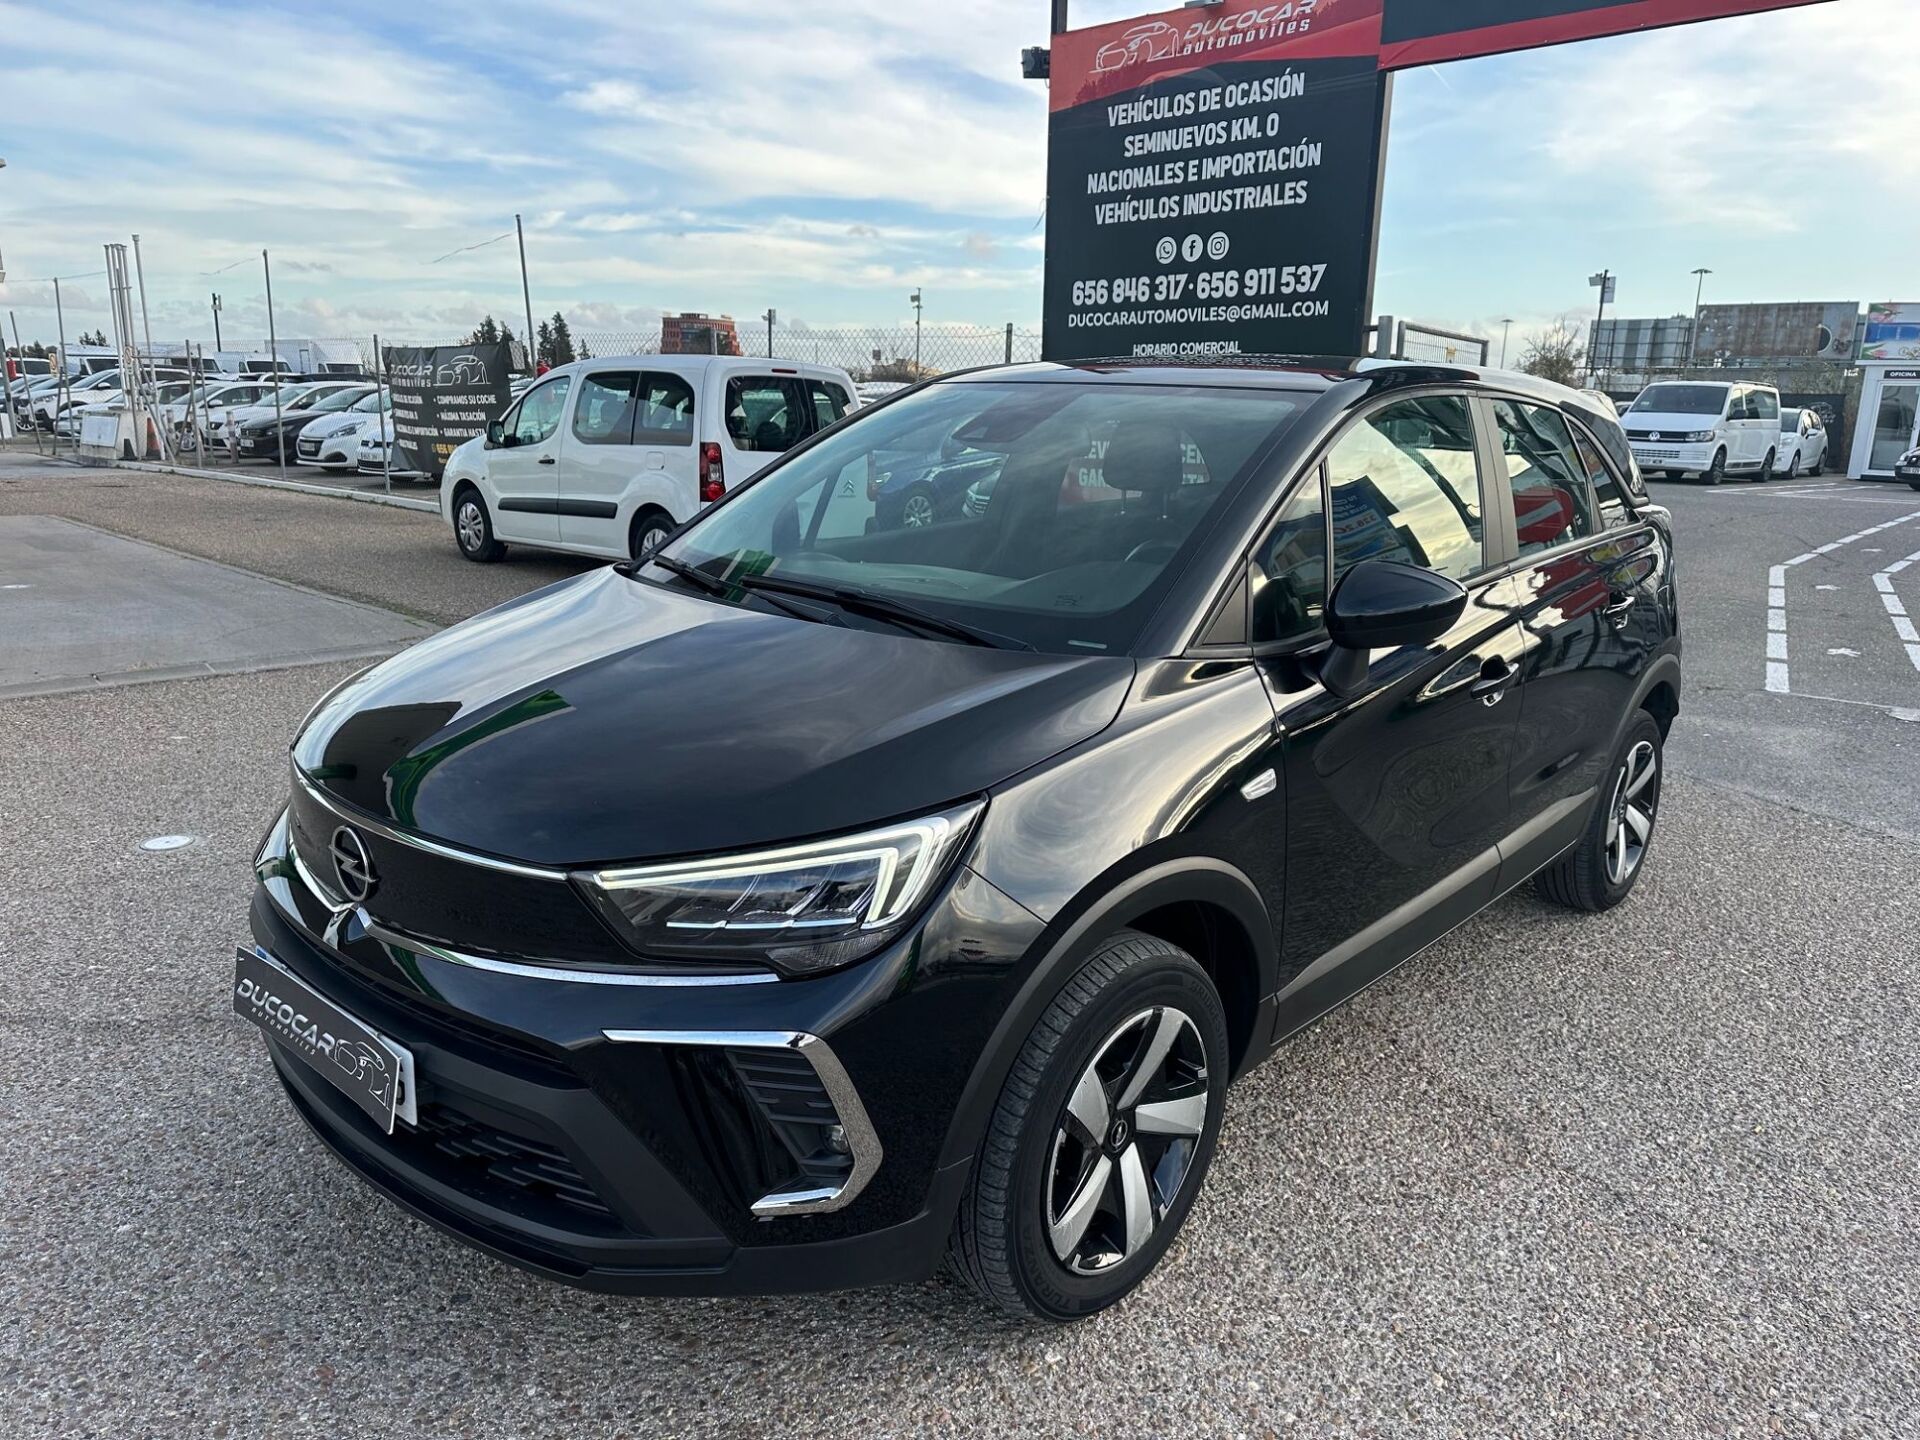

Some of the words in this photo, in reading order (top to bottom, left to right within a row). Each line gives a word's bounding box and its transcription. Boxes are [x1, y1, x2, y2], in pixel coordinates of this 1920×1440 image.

[1183, 19, 1310, 55] automoviles
[1184, 0, 1317, 40] DUCOCAR
[1107, 94, 1195, 127] VEHÍCULOS
[1199, 87, 1221, 113] DE
[1224, 67, 1305, 108] OCASIÓN
[1124, 122, 1228, 157] SEMINUEVOS
[1231, 115, 1262, 142] KM.
[1087, 161, 1184, 194] NACIONALES
[1187, 159, 1199, 182] E
[1201, 137, 1322, 180] IMPORTACIÓN
[1095, 194, 1180, 225] VEHÍCULOS
[1182, 180, 1308, 216] INDUSTRIALES
[1072, 279, 1108, 306] 656
[1112, 276, 1150, 303] 846
[1244, 267, 1276, 296] 911
[1280, 263, 1327, 295] 537
[1068, 300, 1329, 327] DUCOCARAUTOMOVILES@GMAIL.COM
[1132, 343, 1178, 356] HORARIO
[1179, 341, 1242, 355] COMERCIAL
[236, 978, 336, 1058] DUCOCAR
[251, 1006, 316, 1056] AUTOMOVILES
